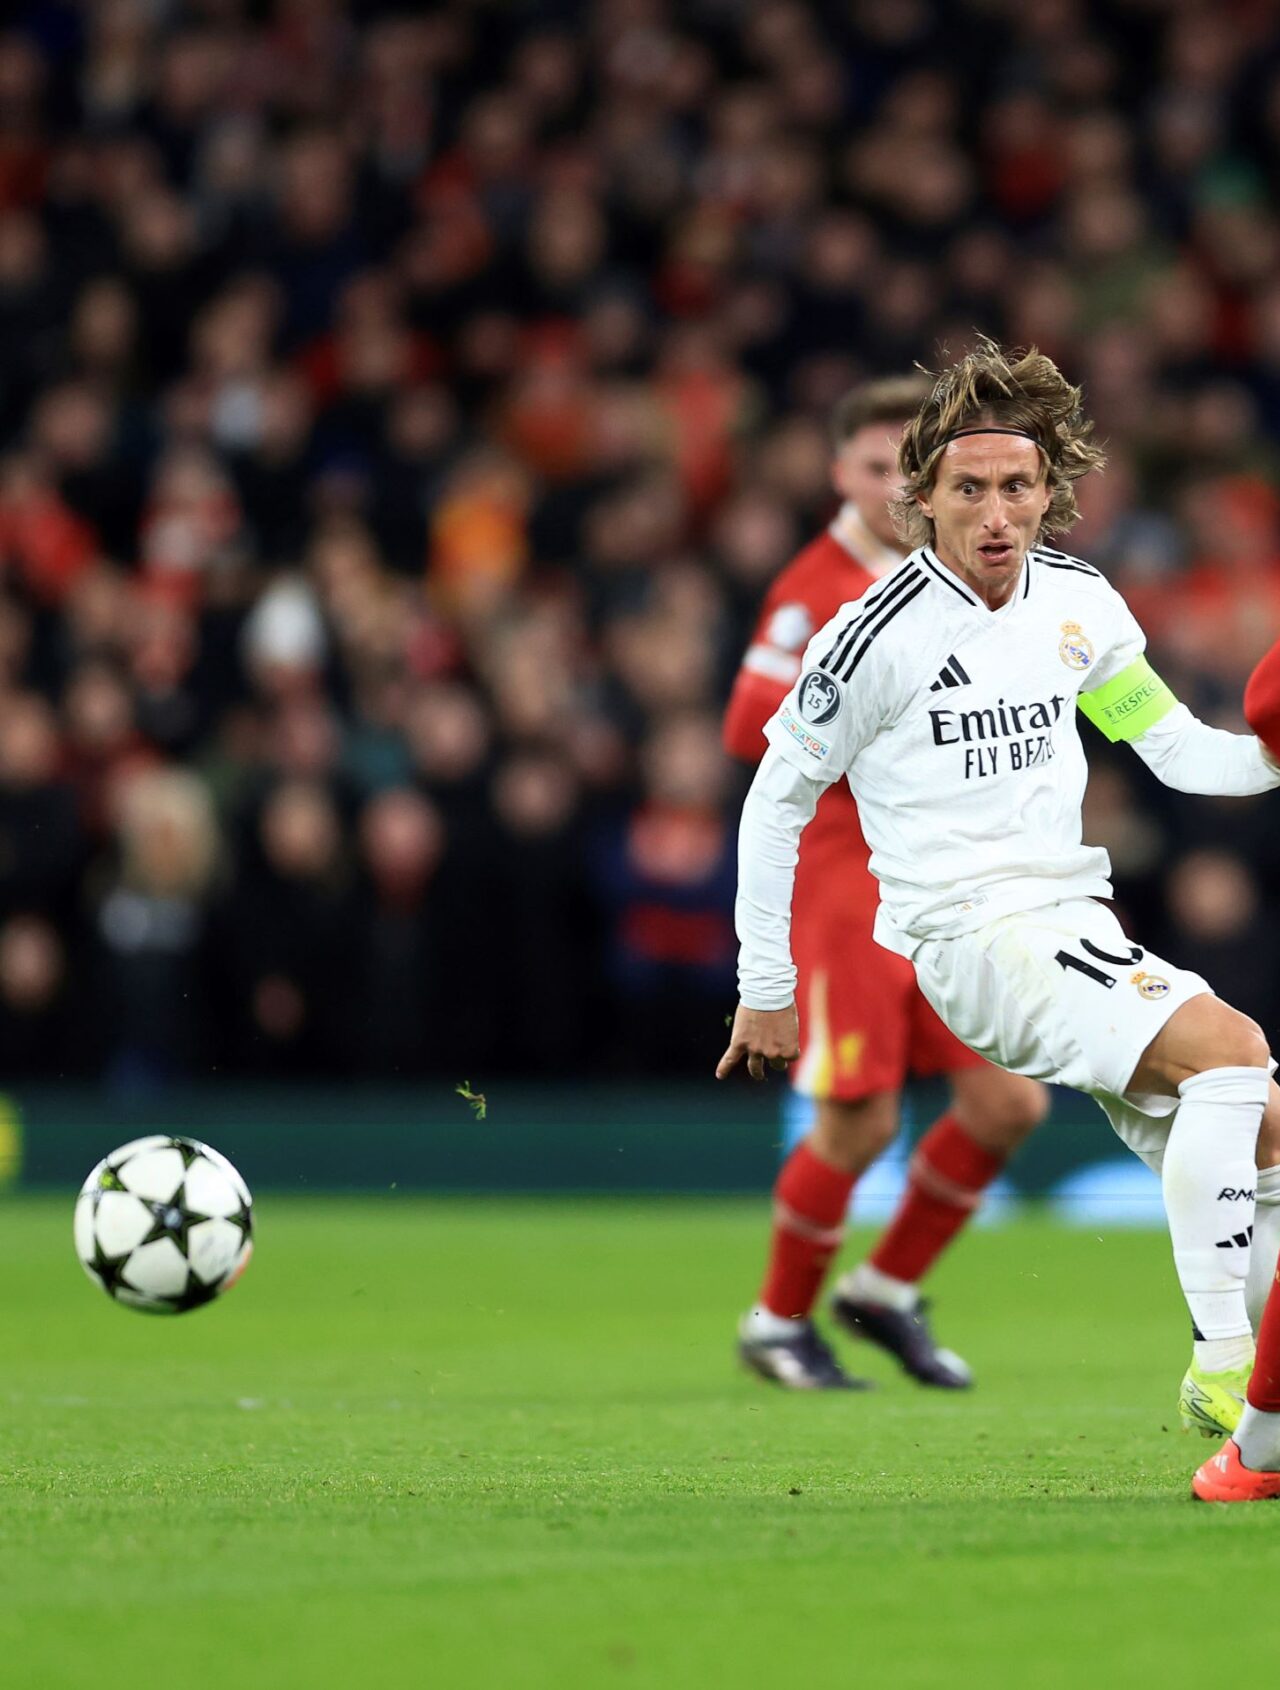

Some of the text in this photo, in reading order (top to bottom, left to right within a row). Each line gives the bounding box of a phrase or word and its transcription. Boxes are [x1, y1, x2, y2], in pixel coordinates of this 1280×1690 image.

[807, 693, 823, 710] 15
[1115, 679, 1159, 717] RESPEC
[965, 746, 997, 779] FLY
